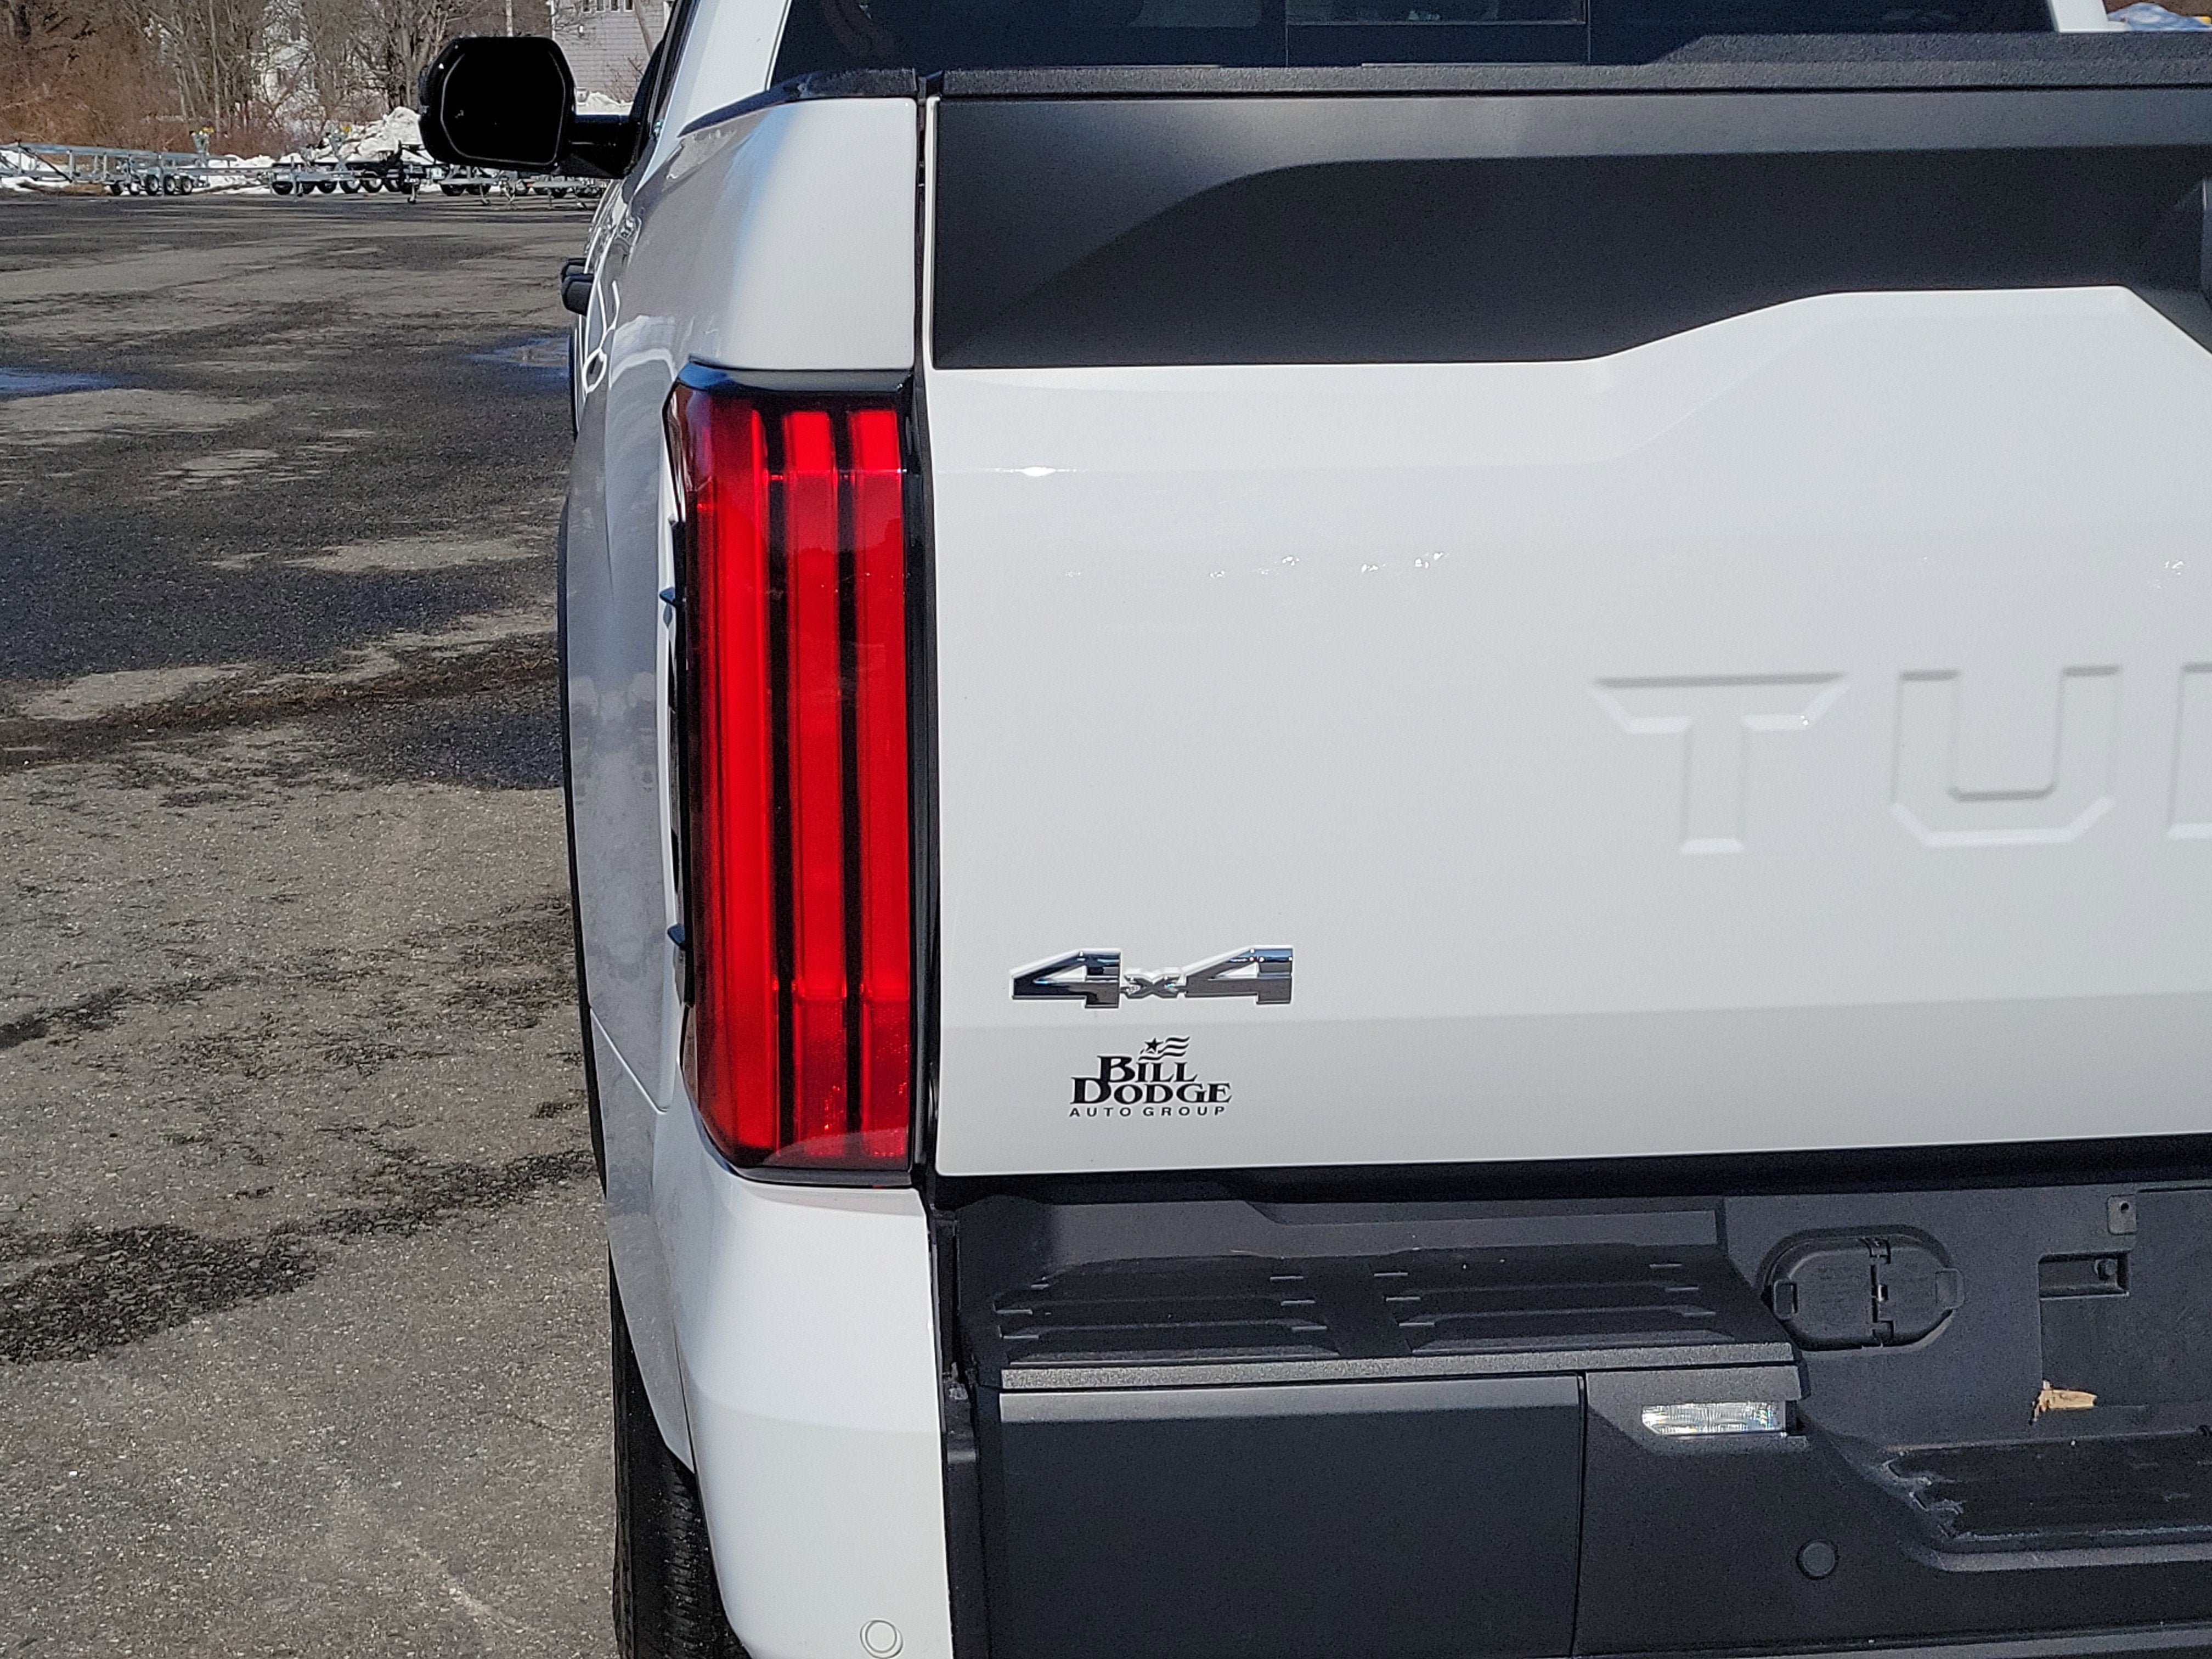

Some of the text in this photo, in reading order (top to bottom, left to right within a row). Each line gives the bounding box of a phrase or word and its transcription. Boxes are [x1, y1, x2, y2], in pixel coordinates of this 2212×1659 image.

[1592, 663, 2212, 854] TU
[1011, 945, 1294, 1008] 4x4
[1097, 1056, 1199, 1083] BILL
[1070, 1077, 1232, 1105] DODGE
[1069, 1106, 1226, 1118] AUTO GROUP
